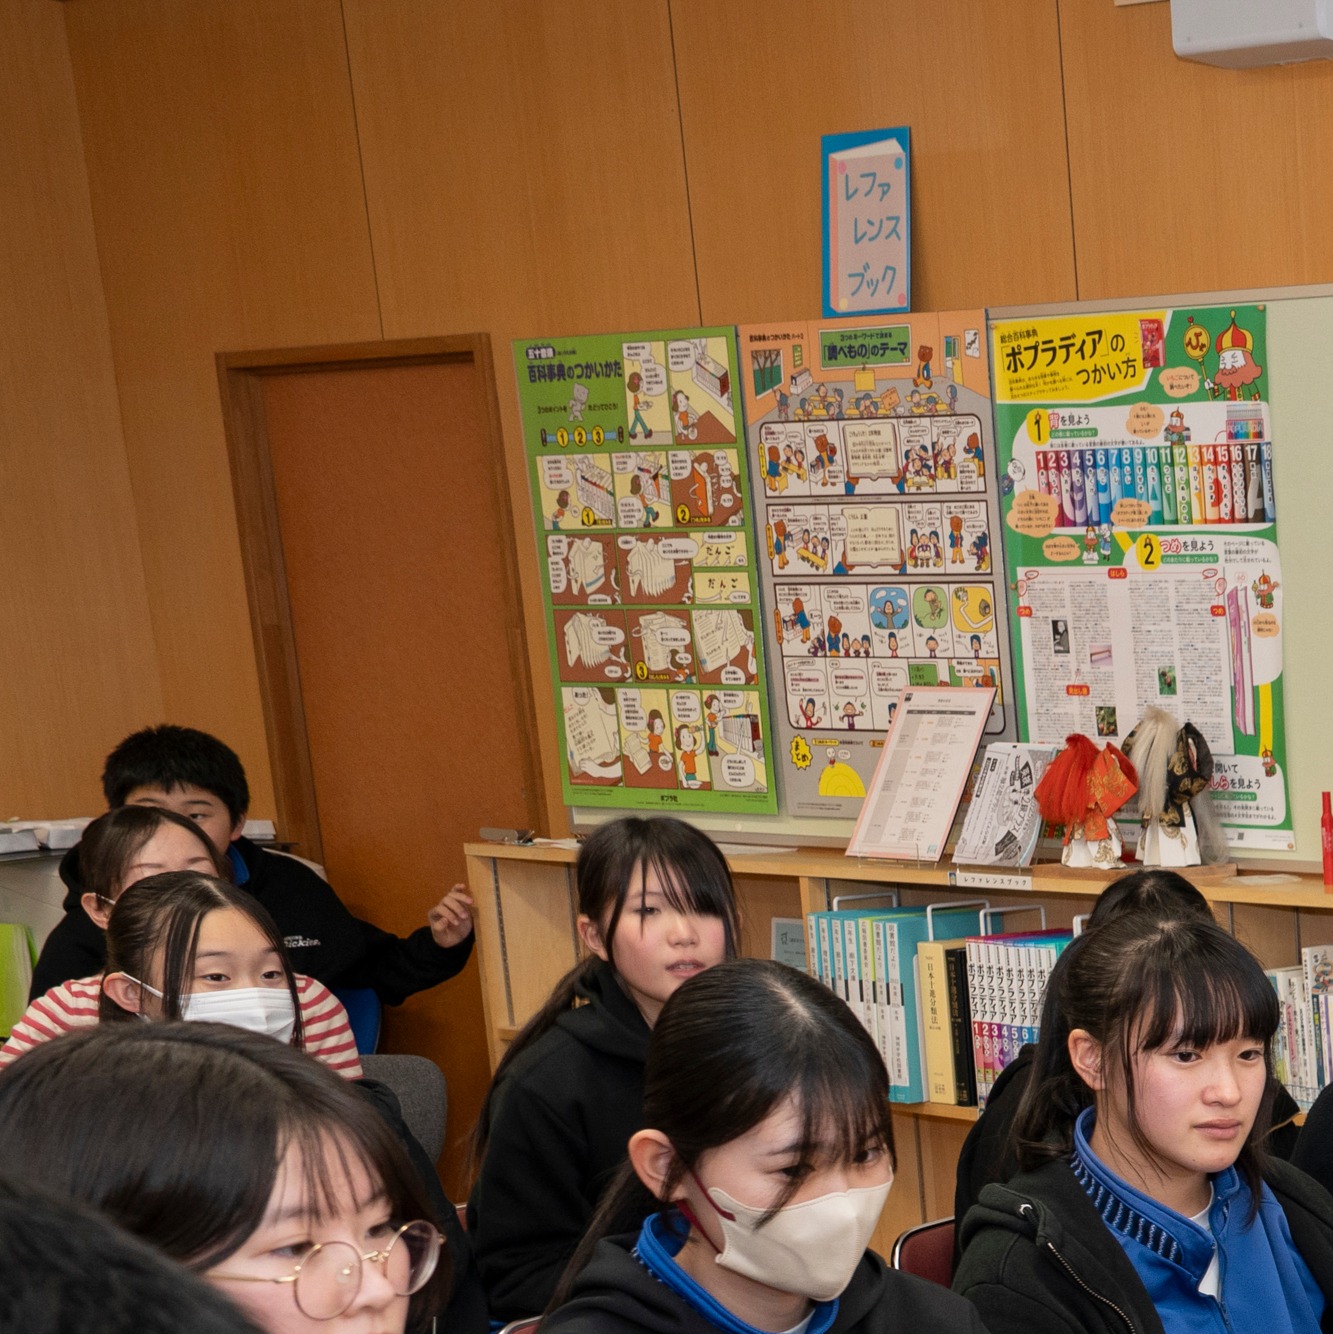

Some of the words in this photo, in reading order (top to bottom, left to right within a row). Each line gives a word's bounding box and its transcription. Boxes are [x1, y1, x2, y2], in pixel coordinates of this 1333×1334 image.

[845, 171, 892, 202] レファ
[854, 215, 901, 245] レンス
[848, 262, 896, 297] ブック
[1000, 330, 1039, 344] 総合百科事典
[527, 360, 623, 383] 百科事典のつかいかた
[1076, 356, 1137, 385] つかい方
[1048, 412, 1090, 430] 背を見よう
[1060, 453, 1069, 466] 3
[1072, 452, 1080, 466] 4
[1085, 452, 1093, 466] 5
[1097, 451, 1105, 465] 6
[1111, 451, 1118, 465] 7
[1122, 450, 1131, 464] 8
[1135, 450, 1143, 464] 9
[1146, 449, 1157, 463] 10
[1160, 449, 1171, 462] 11
[1175, 448, 1187, 462] 12
[1188, 447, 1200, 461] 13
[1203, 447, 1214, 461] 14
[1217, 446, 1229, 461] 15
[1231, 446, 1242, 460] 16
[1246, 445, 1258, 460] 17
[1038, 454, 1045, 467] 1
[1048, 453, 1056, 467] 2
[1160, 540, 1215, 553] つめを見よう
[1144, 543, 1155, 565] 2
[1109, 570, 1126, 578] はしら
[1212, 762, 1238, 774] 開いて
[1208, 776, 1261, 790] しらを見よう
[964, 876, 1027, 886] レファレンスブック
[927, 962, 938, 1024] 日本十進分類法
[974, 1024, 979, 1034] 1
[982, 1024, 989, 1035] 2
[991, 1024, 998, 1035] 3
[1002, 1026, 1008, 1036] 4
[1011, 1028, 1018, 1038] 5
[1022, 1028, 1029, 1039] 6
